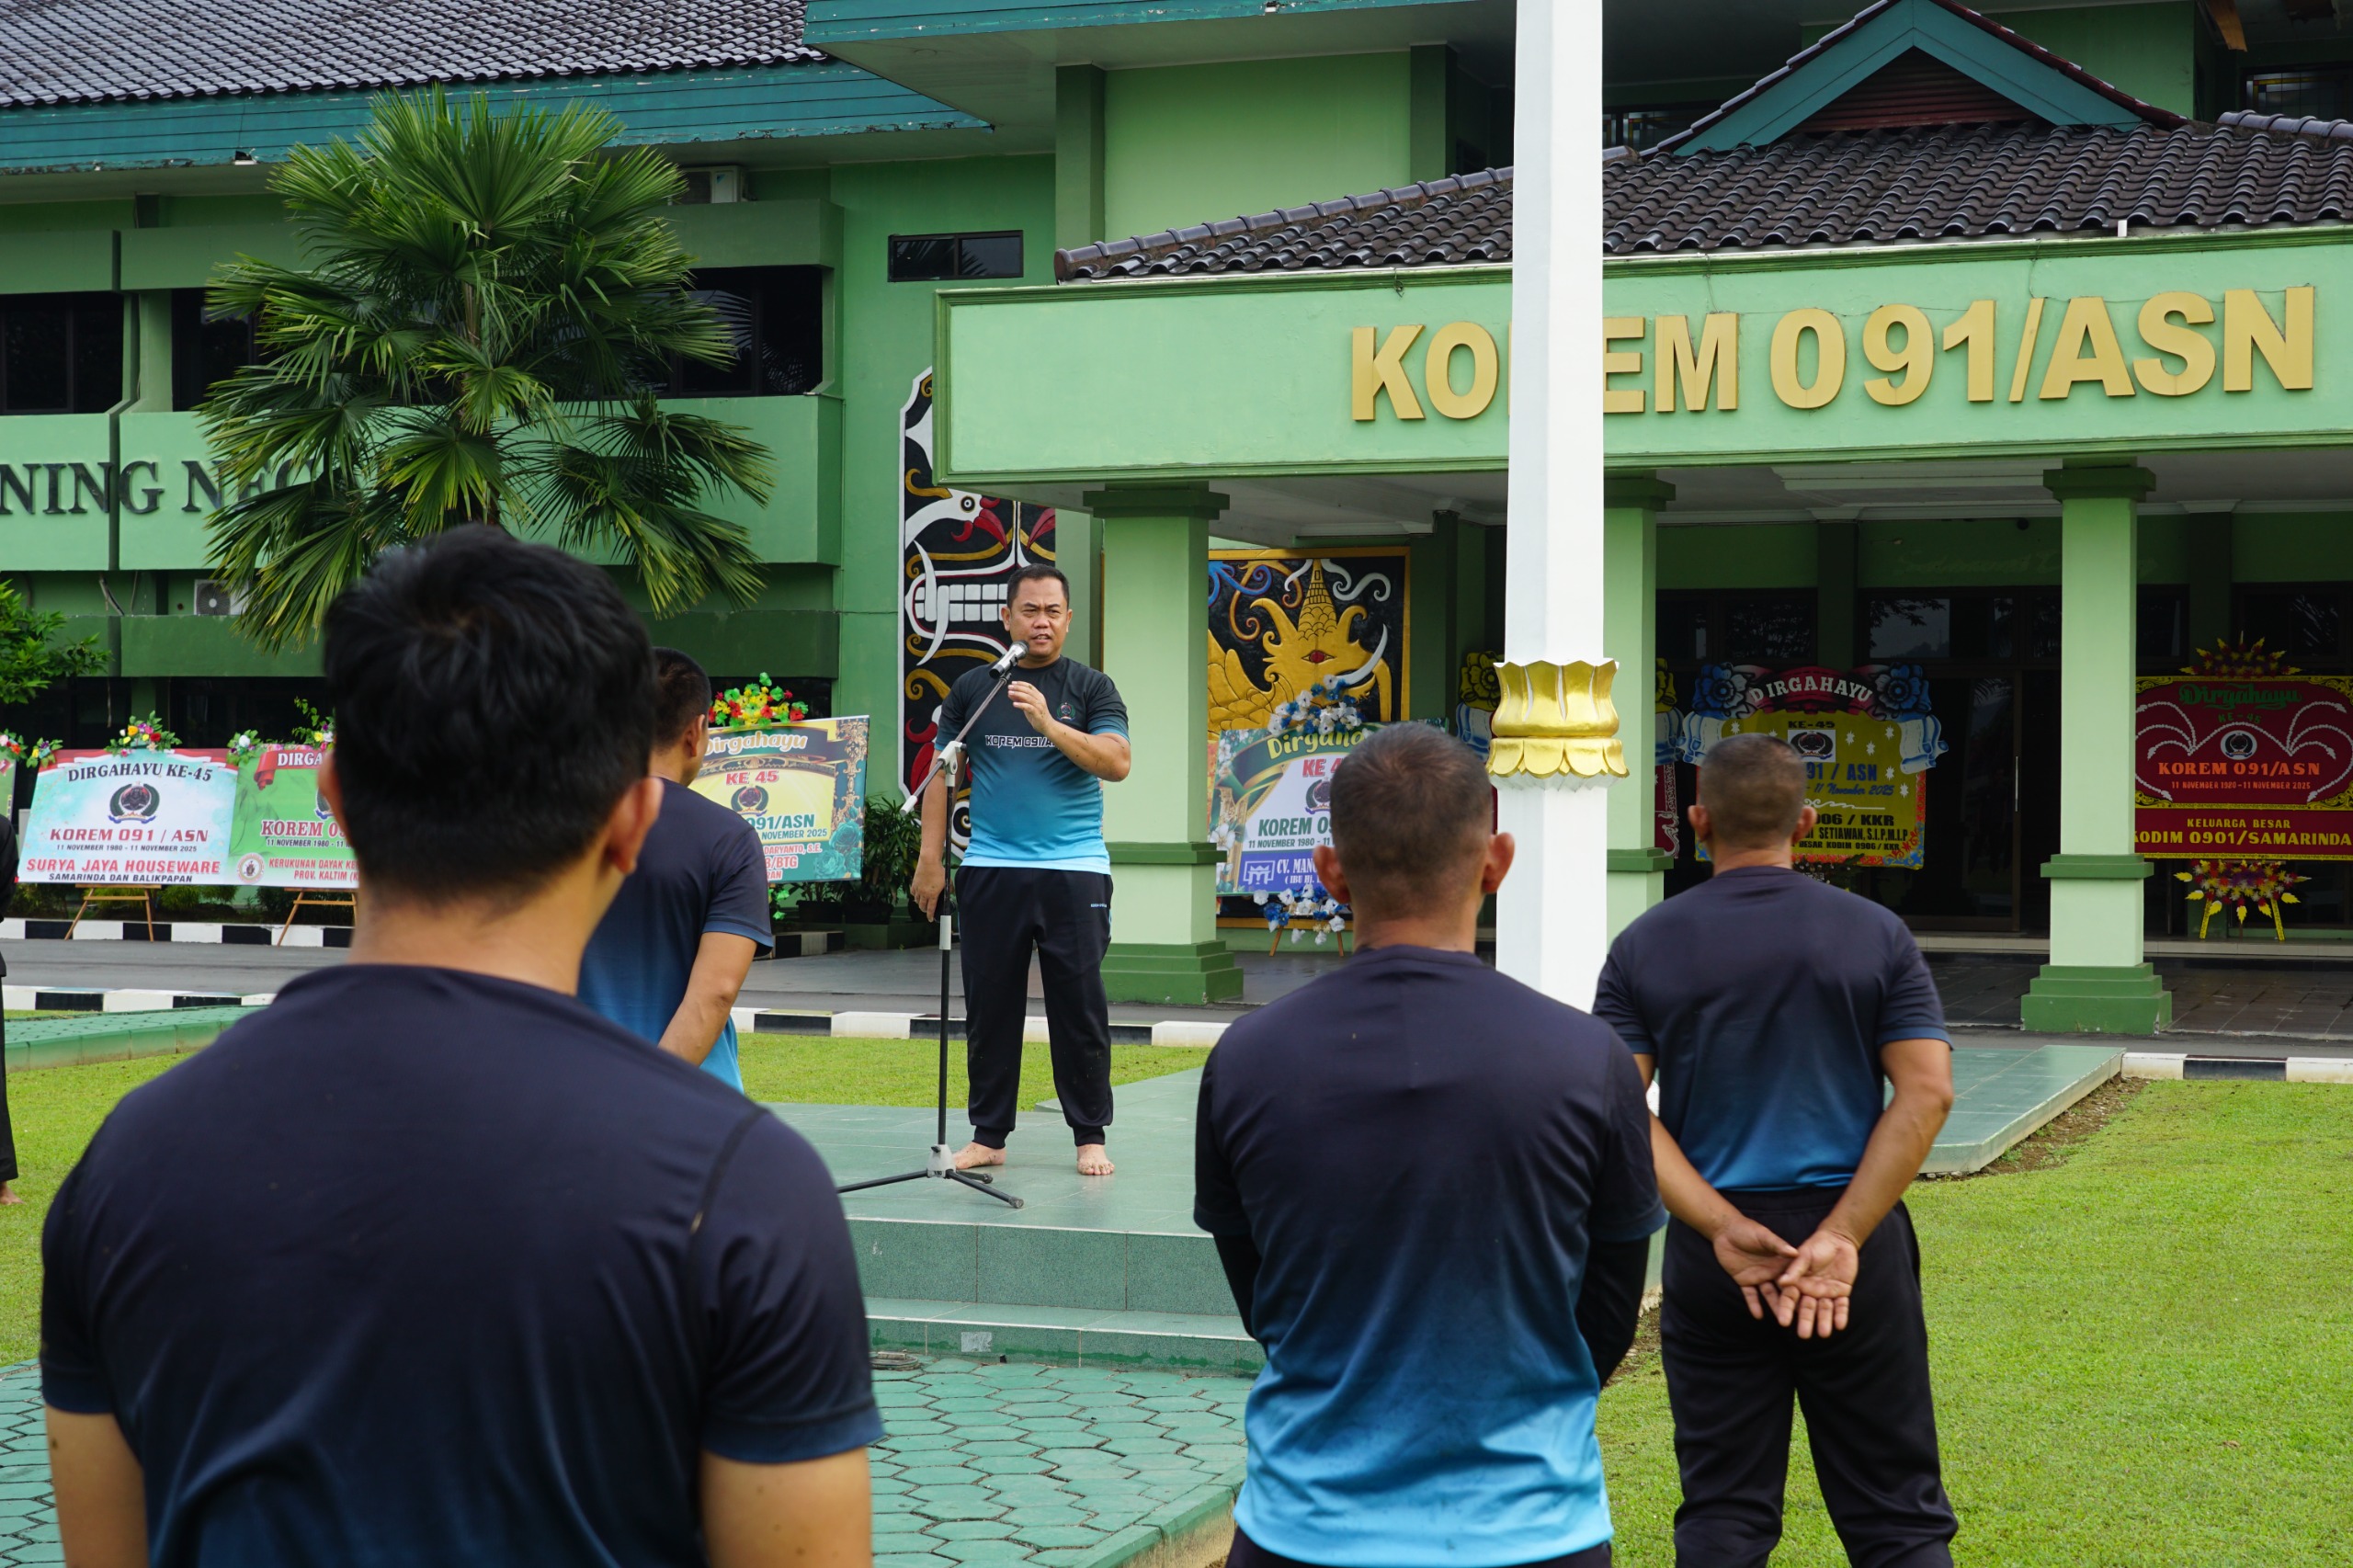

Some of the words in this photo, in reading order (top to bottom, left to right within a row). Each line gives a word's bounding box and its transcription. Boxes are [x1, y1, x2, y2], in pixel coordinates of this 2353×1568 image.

[1352, 312, 1738, 420] KOEM
[1770, 286, 2314, 409] 091/ASN
[1749, 676, 1872, 702] DIRGAHAYU
[2177, 683, 2303, 710] Dirgahayu
[1788, 720, 1836, 729] KE-45
[985, 735, 1023, 749] KOREM
[68, 763, 164, 782] DIRGAHAYU
[166, 763, 212, 782] KE-45
[1302, 758, 1326, 778] KE
[1847, 763, 1878, 781] ASN
[2158, 762, 2227, 776] KOREM
[2234, 761, 2320, 777] 091/ASN
[725, 772, 750, 786] KE
[755, 770, 780, 782] 45
[1869, 784, 1895, 796] 2025
[2182, 781, 2219, 790] NOVEMBER
[2253, 781, 2290, 790] NOVEMBER
[2292, 781, 2311, 790] 2025
[1258, 817, 1313, 836] KOREM
[1861, 814, 1894, 826] KKR
[2187, 818, 2246, 828] KELUARGA
[2252, 819, 2290, 829] BESAR
[261, 821, 324, 836] KOREM
[761, 830, 804, 840] NOVEMBER
[806, 829, 827, 838] 2025
[1819, 827, 1866, 841] SETIAWAN,
[50, 829, 113, 842] KOREM
[119, 829, 154, 841] 091
[171, 829, 209, 842] ASN
[2189, 830, 2352, 846] 0901/SAMARINDA
[179, 845, 198, 853] 2025
[267, 838, 274, 846] 11
[277, 838, 312, 847] NOVEMBER
[313, 839, 329, 847] 1980
[336, 840, 344, 848] 11
[764, 844, 805, 855] DARYANTO,
[807, 843, 823, 853] S.E.
[1248, 840, 1256, 848] 11
[1257, 839, 1295, 848] NOVEMBER
[1298, 837, 1315, 846] 1980
[1323, 837, 1331, 846] 11
[1826, 841, 1852, 849] KODIM
[27, 858, 75, 872] SURYA
[81, 859, 119, 873] JAYA
[125, 859, 221, 874] HOUSEWARE
[268, 858, 316, 869] KERUKUNAN
[318, 859, 343, 869] DAYAK
[1277, 858, 1290, 874] CV.
[49, 873, 106, 881] SAMARINDA
[109, 873, 129, 882] DAN
[132, 874, 193, 883] BALIKPAPAN
[293, 870, 316, 881] PROV.
[318, 871, 347, 881] KALTIM
[1290, 875, 1303, 884] IBU
